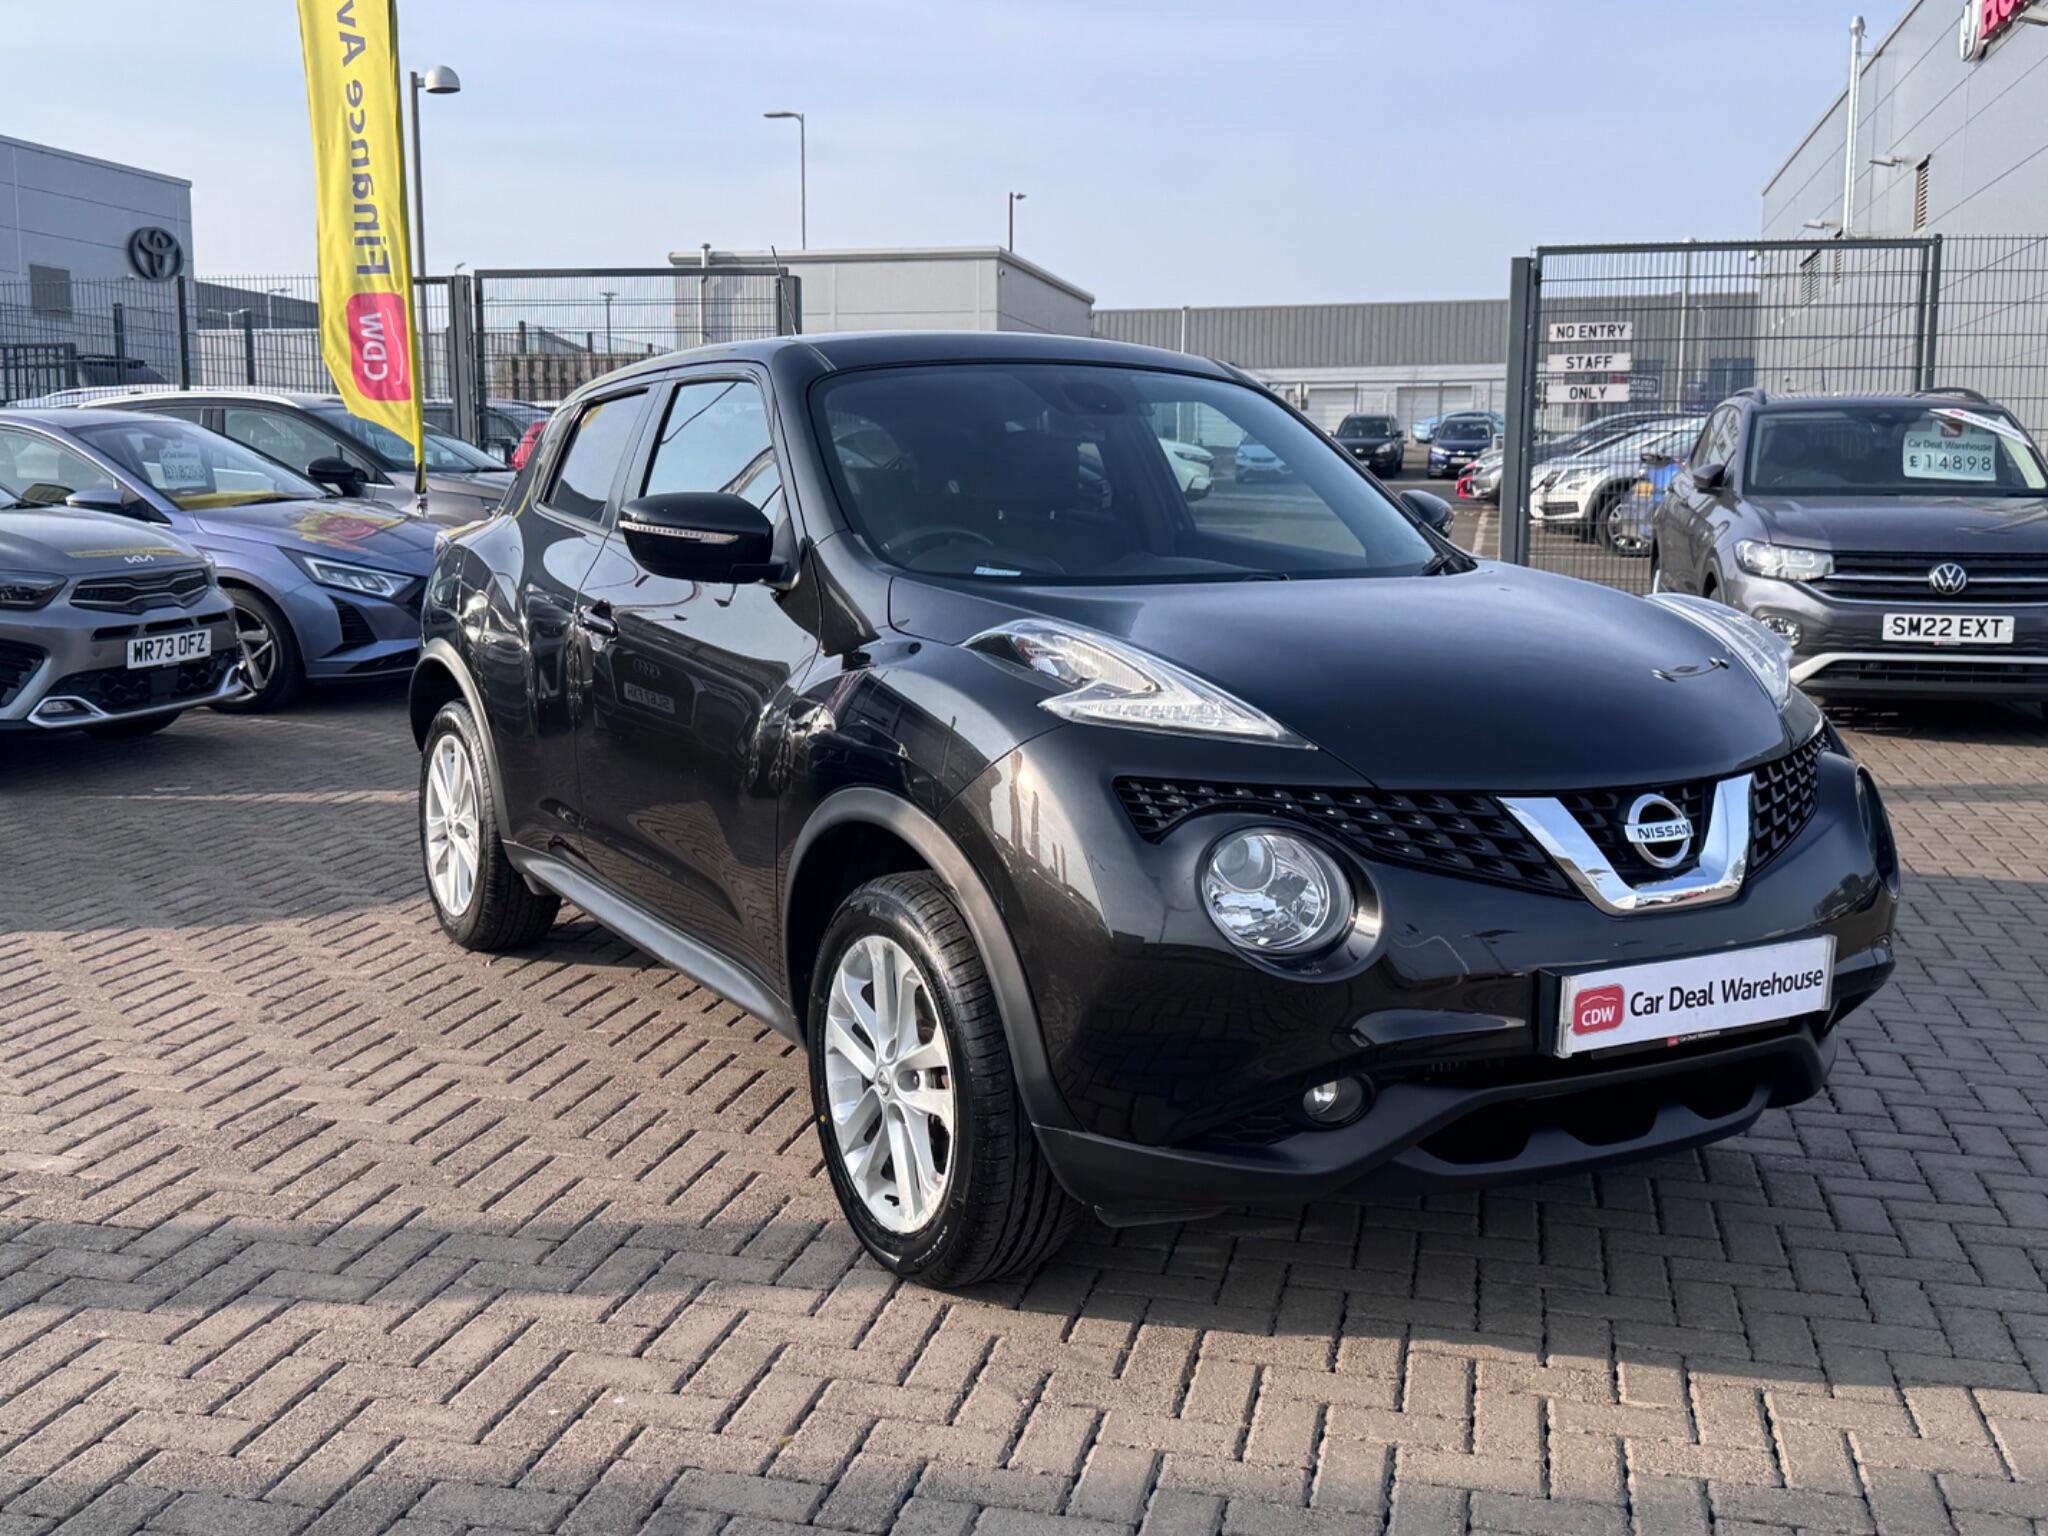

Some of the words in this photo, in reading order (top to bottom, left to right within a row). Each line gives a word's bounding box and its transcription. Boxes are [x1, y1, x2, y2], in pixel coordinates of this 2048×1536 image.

[1556, 325, 1575, 339] NO
[1578, 324, 1626, 338] ENTRY
[1566, 355, 1613, 370] STAFF
[1569, 386, 1607, 400] ONLY
[1908, 439, 1921, 448] Car
[1923, 439, 1942, 449] Deal
[1945, 440, 1992, 450] Warehouse
[1909, 454, 1992, 472] £14898
[1892, 616, 1952, 637] SM22
[1959, 618, 2004, 638] EXT
[133, 637, 174, 663] WR73
[178, 632, 206, 656] OFZ
[1637, 823, 1690, 840] NISSAN
[1581, 1006, 1616, 1027] CDW
[1630, 991, 1664, 1017] Car
[1669, 981, 1715, 1012] Deal
[1721, 968, 1824, 1002] Warehouse
